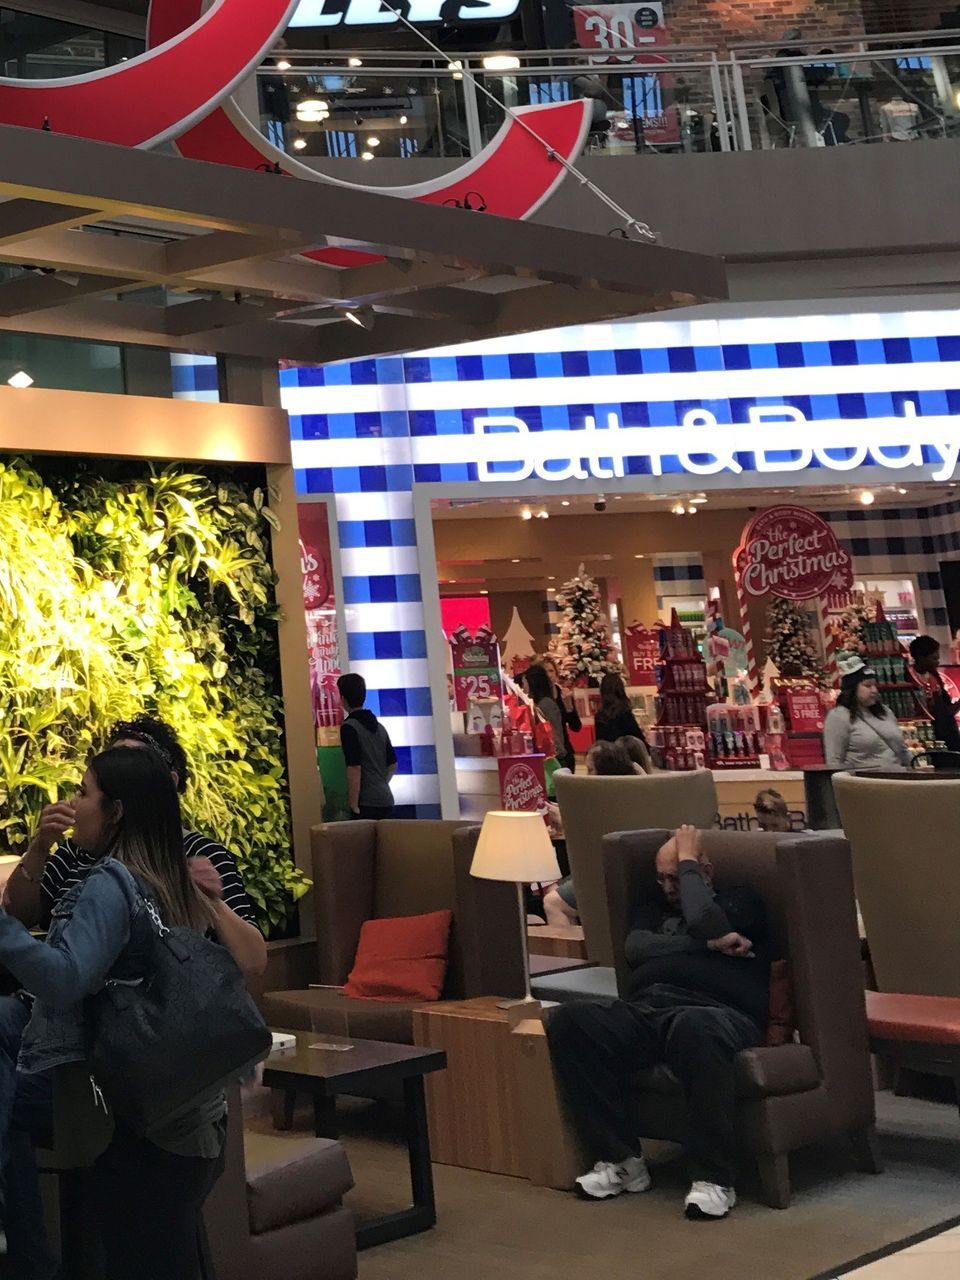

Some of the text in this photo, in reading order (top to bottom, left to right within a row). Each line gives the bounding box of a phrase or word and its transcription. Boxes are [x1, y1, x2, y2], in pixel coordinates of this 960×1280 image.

[766, 525, 788, 542] the
[749, 530, 828, 563] Perfect
[744, 549, 849, 596] Christmas
[633, 657, 664, 671] FRE
[461, 675, 491, 698] $25
[801, 709, 821, 719] FREE
